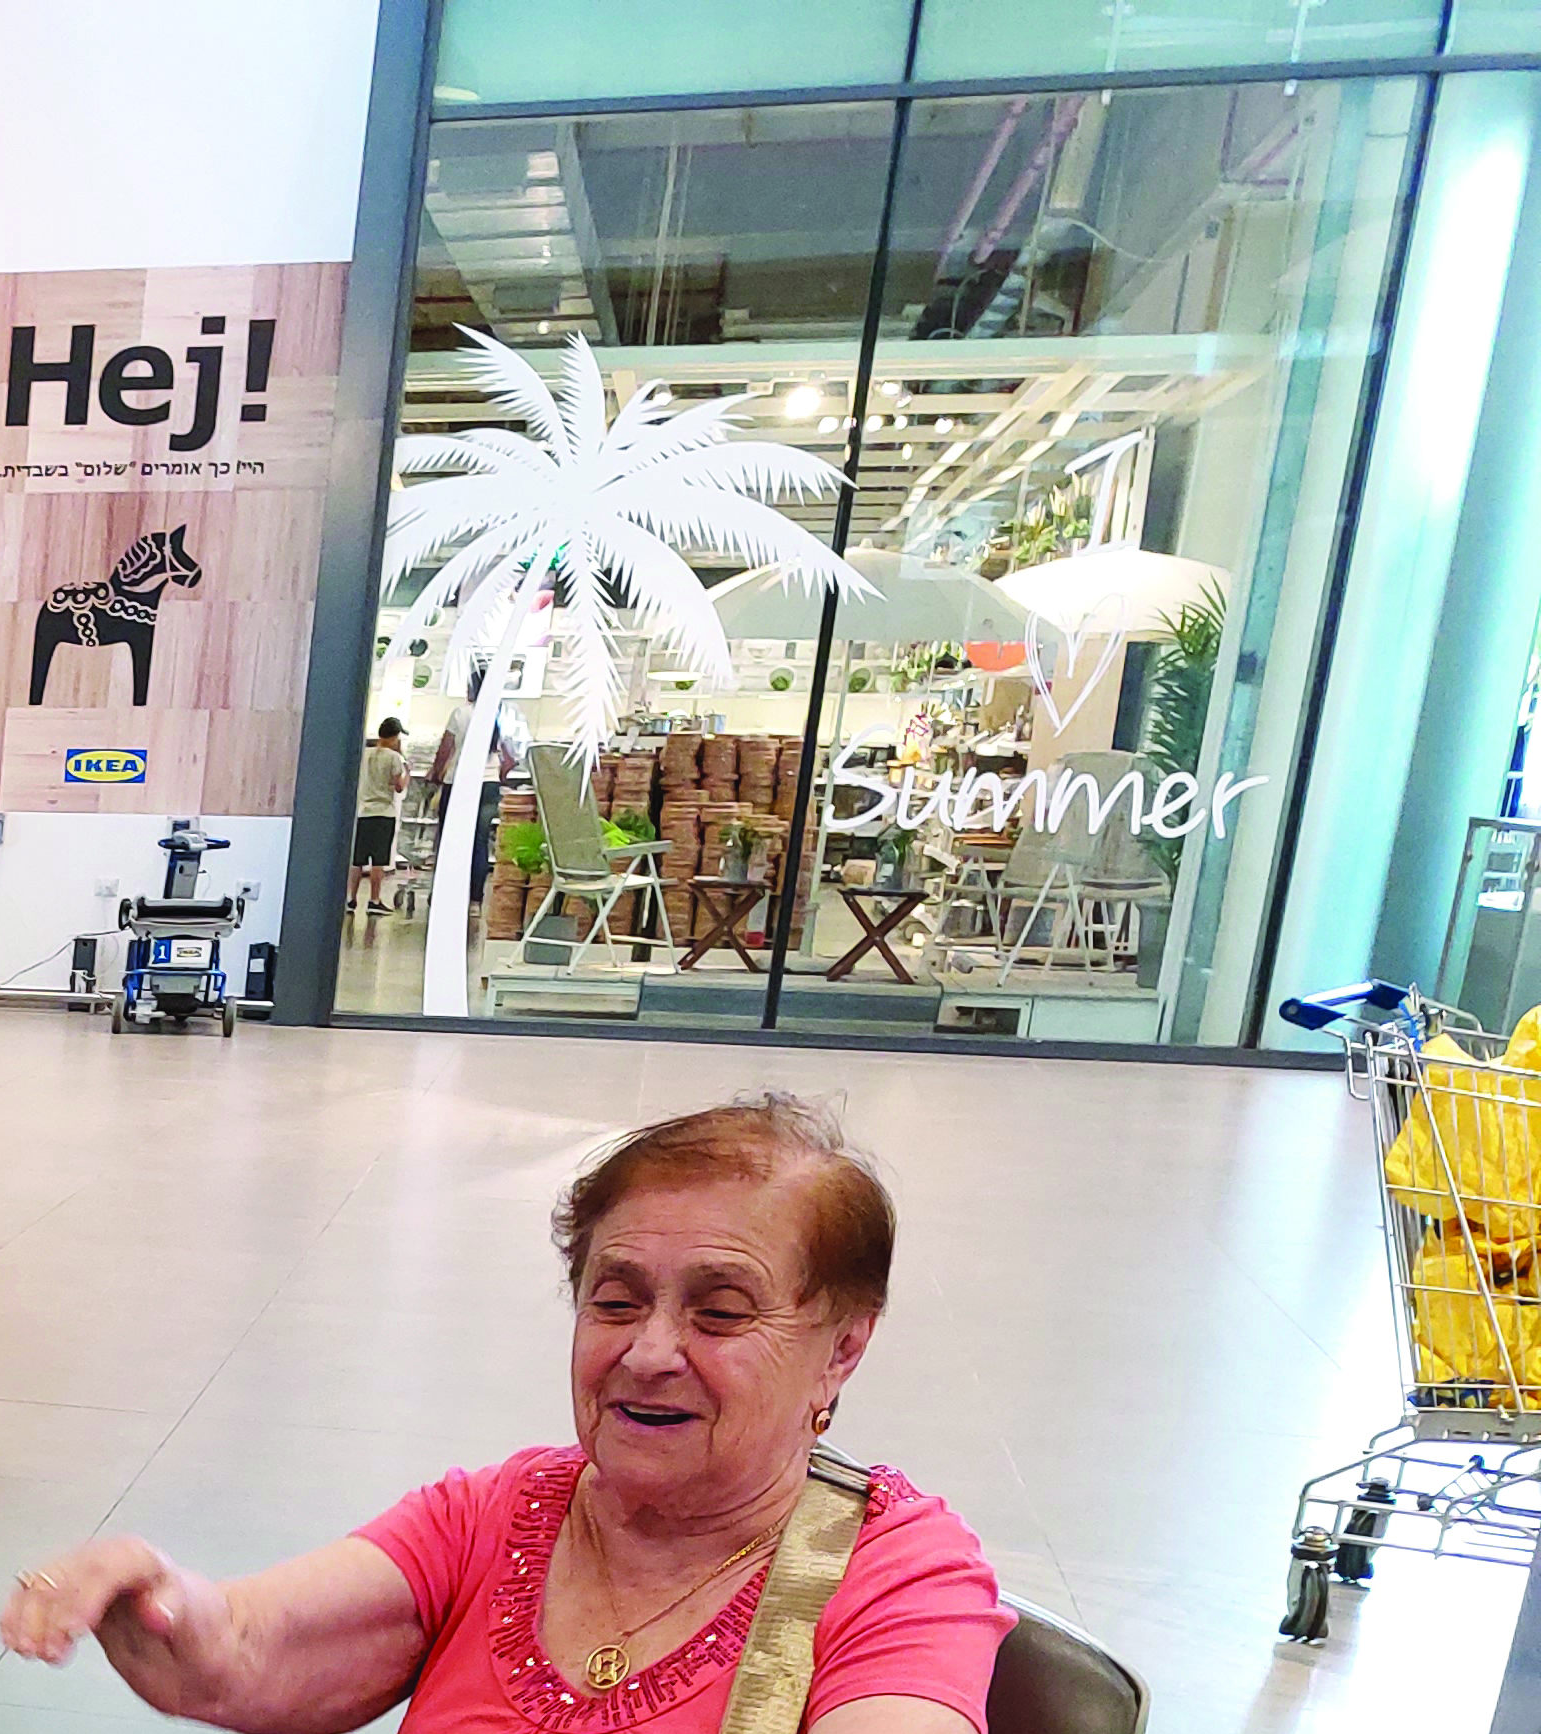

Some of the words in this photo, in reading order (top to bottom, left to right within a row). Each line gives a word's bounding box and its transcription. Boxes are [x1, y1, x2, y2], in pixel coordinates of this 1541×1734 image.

[5, 316, 277, 452] Hej!
[140, 461, 203, 477] אומרים
[207, 462, 231, 479] כך
[73, 759, 139, 773] IKEA
[822, 724, 1271, 840] Summer
